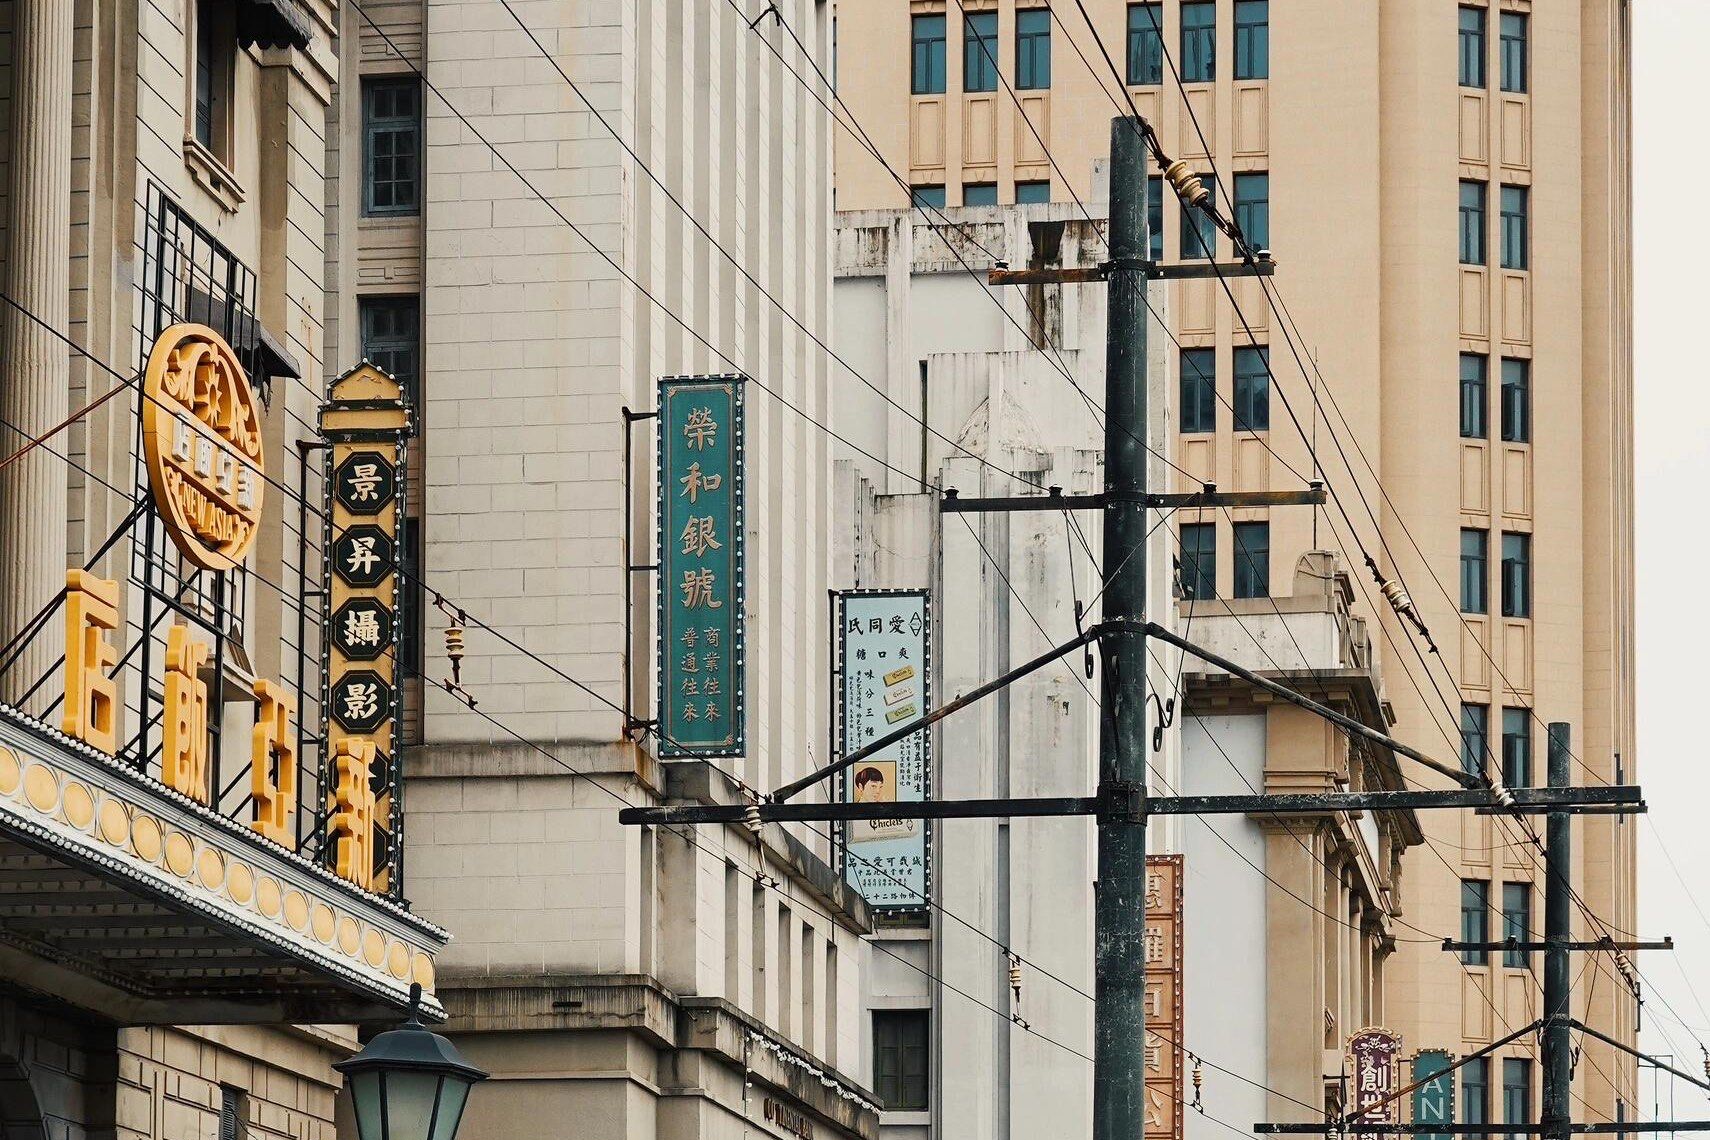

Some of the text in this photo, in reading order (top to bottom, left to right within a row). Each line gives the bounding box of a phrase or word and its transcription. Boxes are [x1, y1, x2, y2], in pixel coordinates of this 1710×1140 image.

[182, 481, 235, 542] NEW ASIA
[680, 406, 723, 610] 榮和銀號
[680, 627, 700, 723] 普通往來
[703, 626, 721, 722] 商業往來
